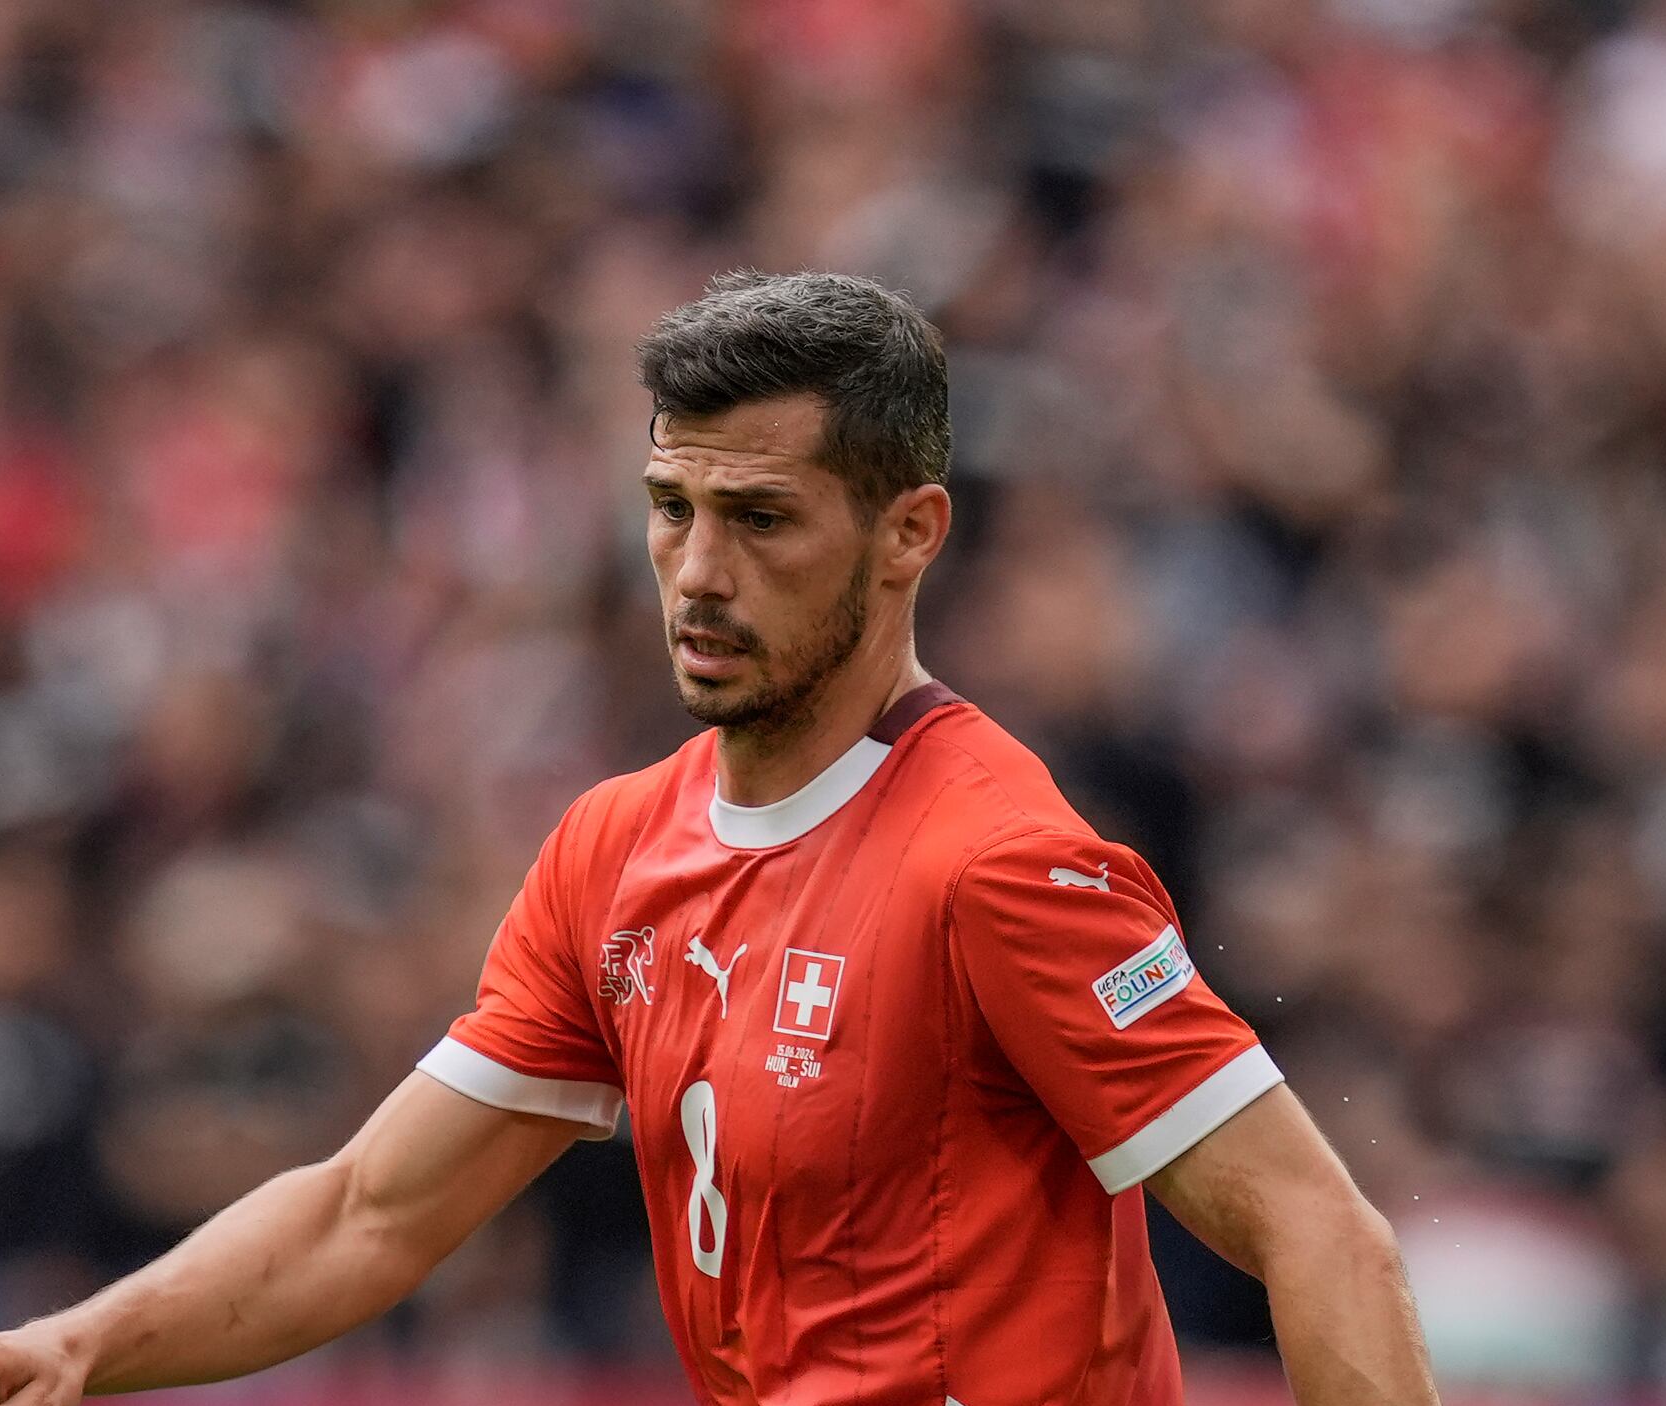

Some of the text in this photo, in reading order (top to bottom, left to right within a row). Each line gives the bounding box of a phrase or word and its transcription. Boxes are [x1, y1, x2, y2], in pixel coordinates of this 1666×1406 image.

[1097, 970, 1128, 994] UEFA
[1104, 943, 1187, 1012] FOUND
[765, 1055, 788, 1072] HUN
[800, 1060, 821, 1078] SUI
[680, 1079, 727, 1279] 8
